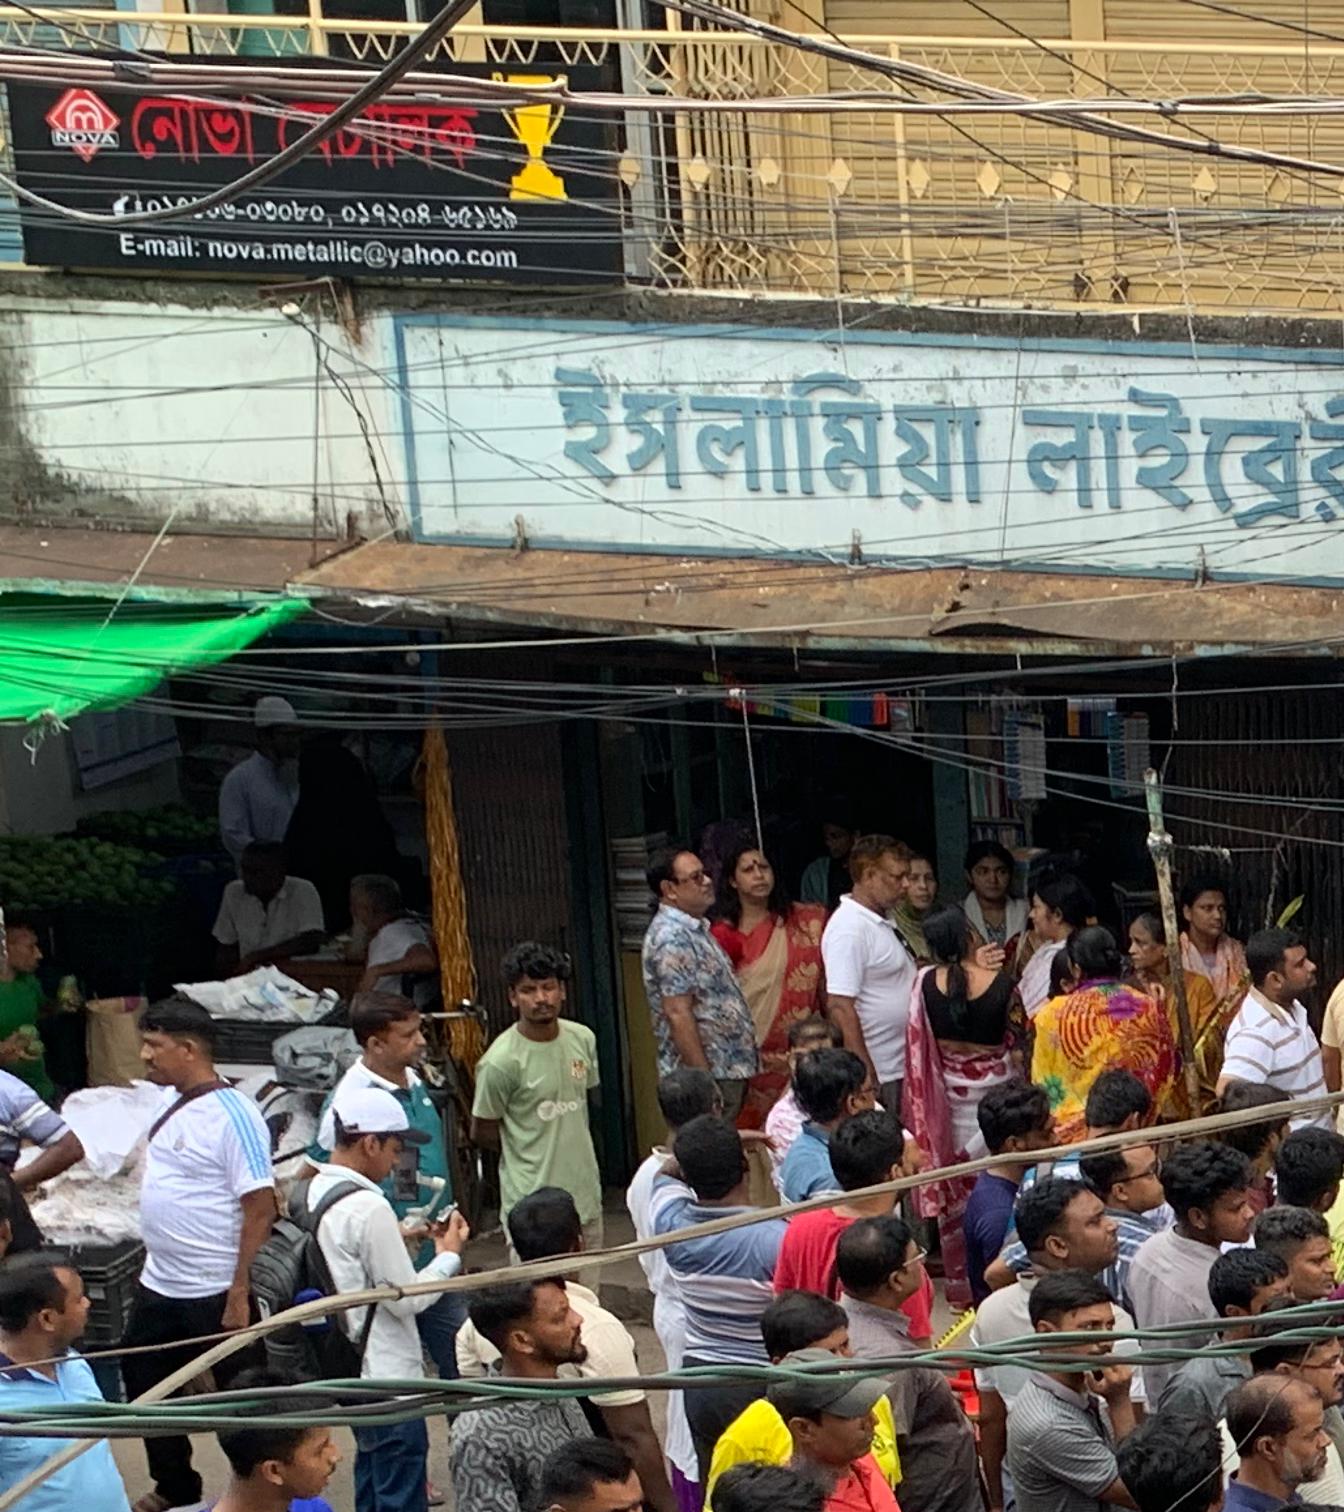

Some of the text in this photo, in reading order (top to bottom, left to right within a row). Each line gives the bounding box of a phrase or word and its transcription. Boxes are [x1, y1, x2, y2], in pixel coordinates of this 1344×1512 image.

[56, 132, 116, 144] NOVA
[120, 234, 518, 269] E-mail: nova.metallic@yahoo.com
